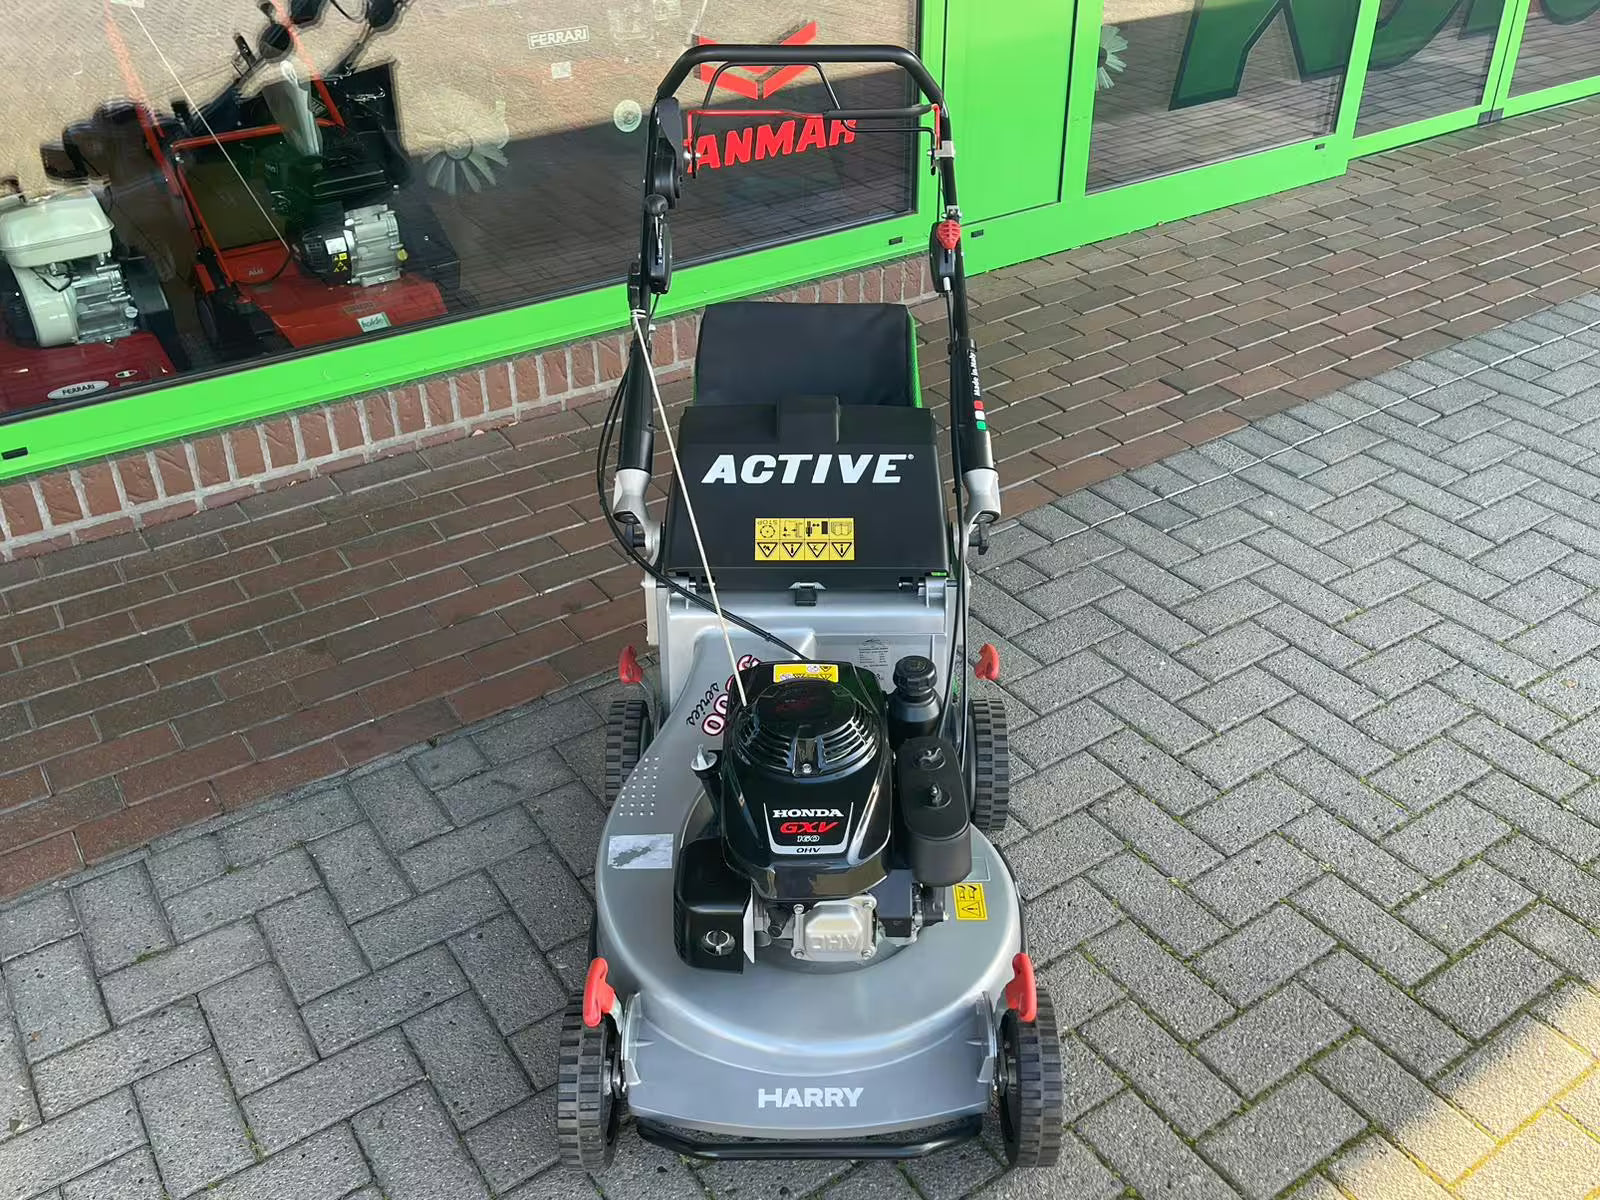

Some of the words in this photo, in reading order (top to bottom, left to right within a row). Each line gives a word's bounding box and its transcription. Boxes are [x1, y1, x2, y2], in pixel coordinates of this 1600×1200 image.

[530, 28, 587, 47] FERRARI
[62, 384, 95, 396] FERRARI
[685, 682, 720, 727] series
[772, 808, 845, 818] HONDA
[780, 821, 840, 834] GXV
[796, 834, 821, 843] 160
[758, 1087, 864, 1109] HARRY
